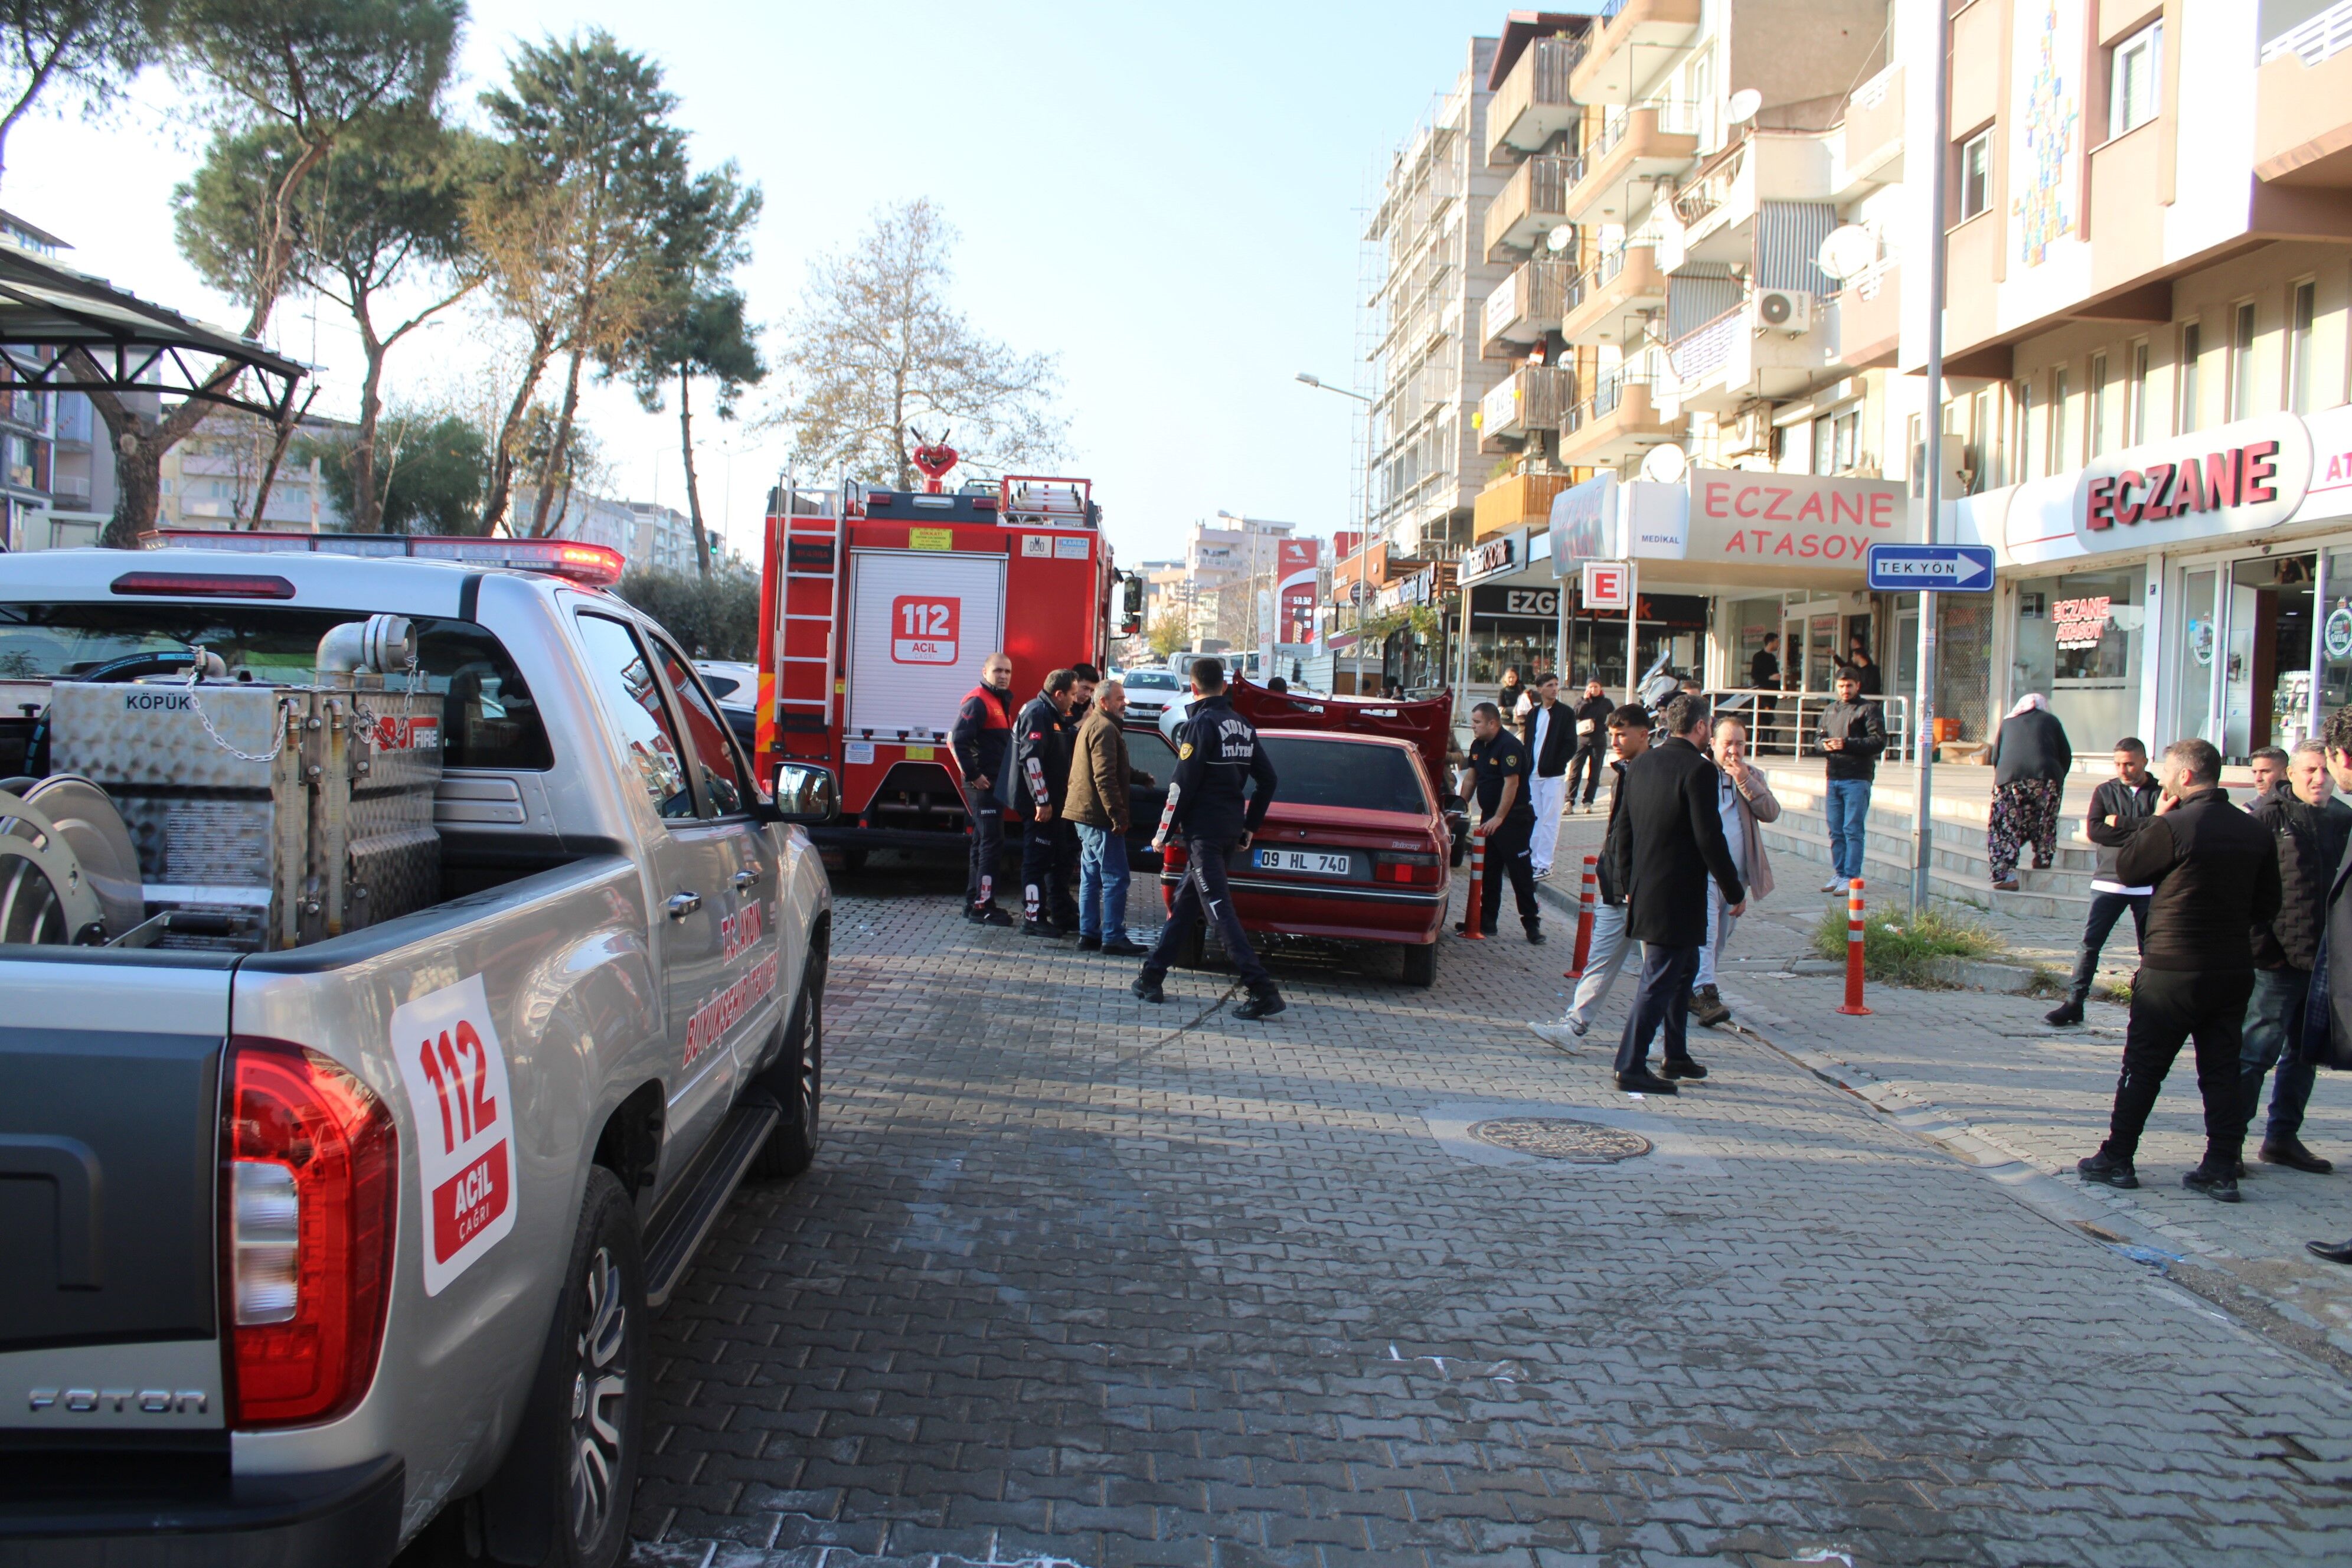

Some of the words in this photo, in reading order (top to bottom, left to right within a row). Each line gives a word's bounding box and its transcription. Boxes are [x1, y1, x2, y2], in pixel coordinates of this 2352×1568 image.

[2086, 440, 2279, 531] ECZANE
[1706, 482, 1894, 527] ECZANE
[1641, 534, 1680, 544] MEDİKAL
[1725, 530, 1870, 560] ATASOY
[1881, 563, 1913, 573] TEK
[1921, 561, 1955, 573] YÖN
[1595, 573, 1617, 598] E
[902, 603, 949, 636] 112
[2052, 596, 2112, 623] ECZANE
[2055, 620, 2103, 642] ATASOY
[912, 642, 937, 653] ACİL
[126, 692, 191, 710] KÖPÜK
[413, 730, 437, 749] FIRE
[1218, 719, 1252, 741] AYDIN
[1392, 841, 1420, 850] Fairway
[1261, 851, 1280, 867] 09
[1290, 854, 1308, 870] HL
[1319, 855, 1347, 873] 740
[721, 913, 739, 966] T.C.
[739, 898, 762, 956] AYDIN
[682, 966, 748, 1070] BÜYÜKŞEHİR
[420, 1020, 497, 1156] 112
[454, 1161, 493, 1221] ACİL
[458, 1202, 489, 1242] ÇAĞRI
[30, 1389, 207, 1413] FOTON
